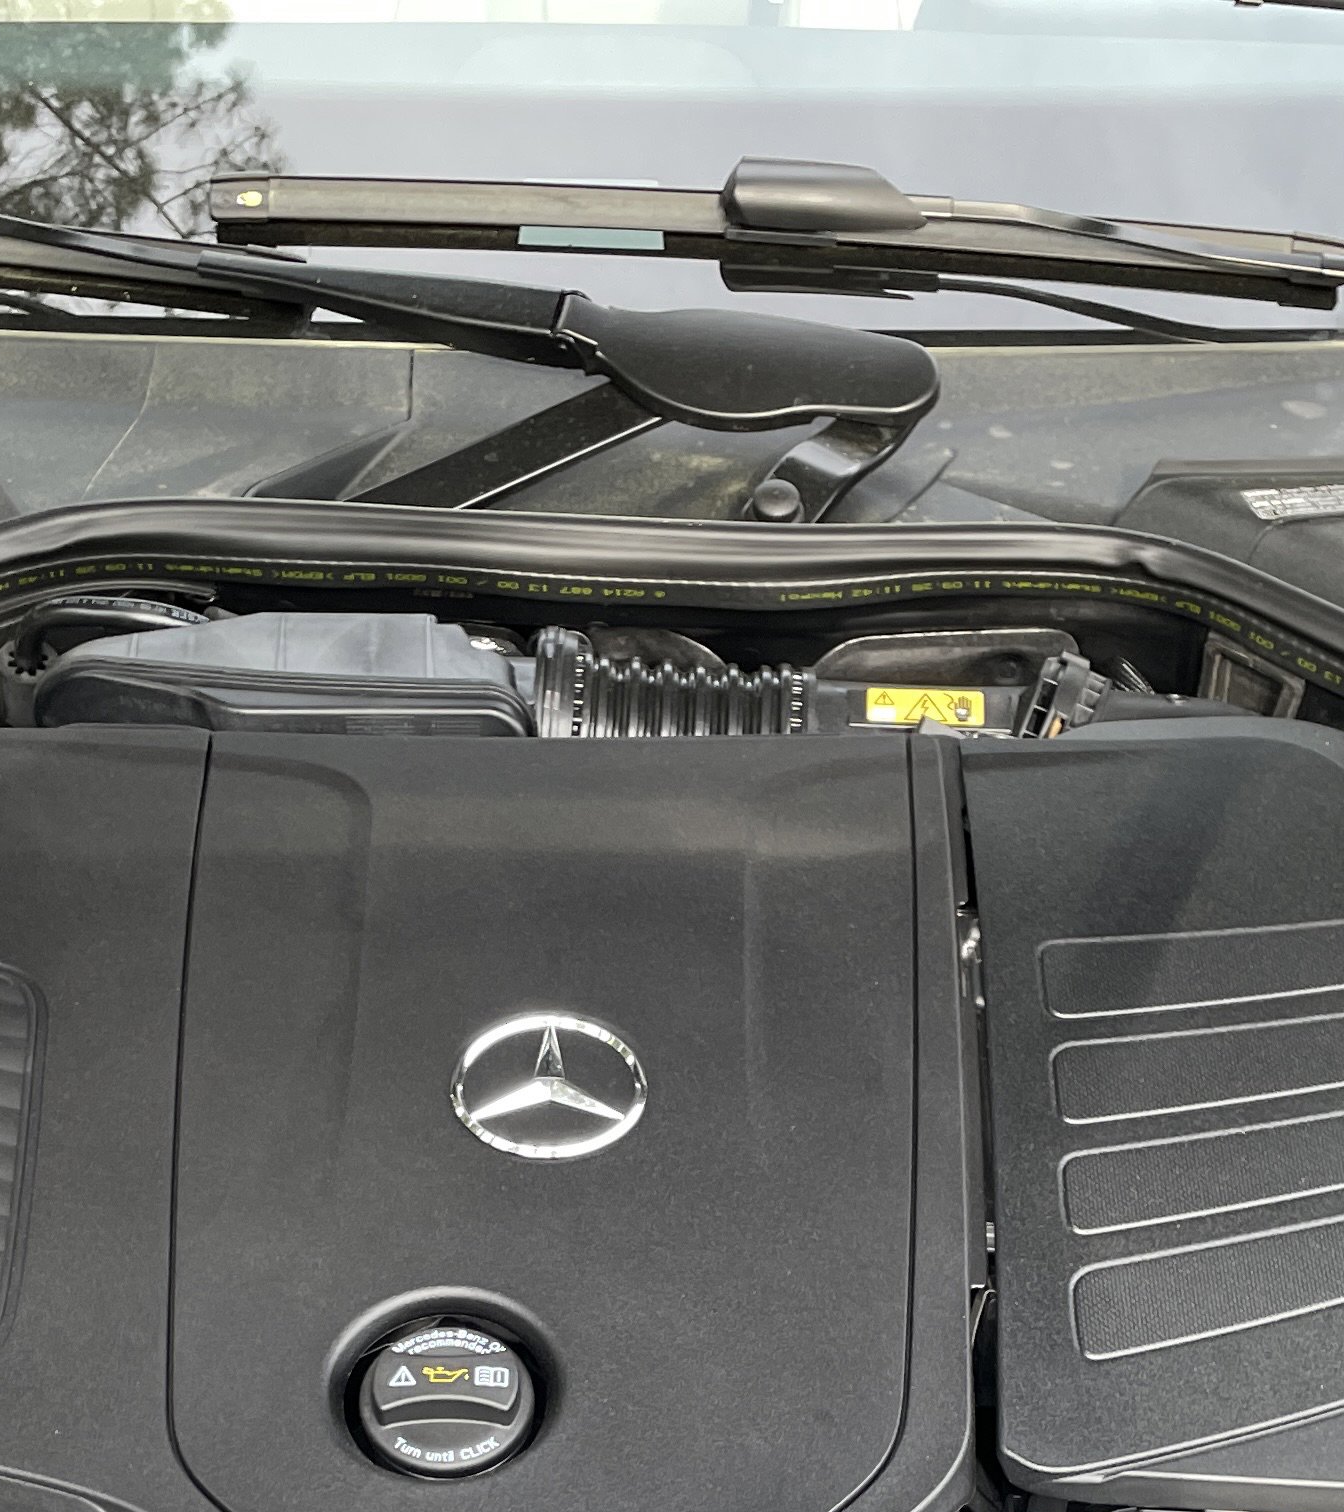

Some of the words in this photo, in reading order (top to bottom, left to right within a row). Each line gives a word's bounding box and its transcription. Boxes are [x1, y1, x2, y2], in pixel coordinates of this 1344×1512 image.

[391, 1329, 489, 1354] Mercedes-Benz
[394, 1436, 421, 1459] Turn
[425, 1450, 455, 1462] until
[459, 1436, 501, 1461] CLICK
